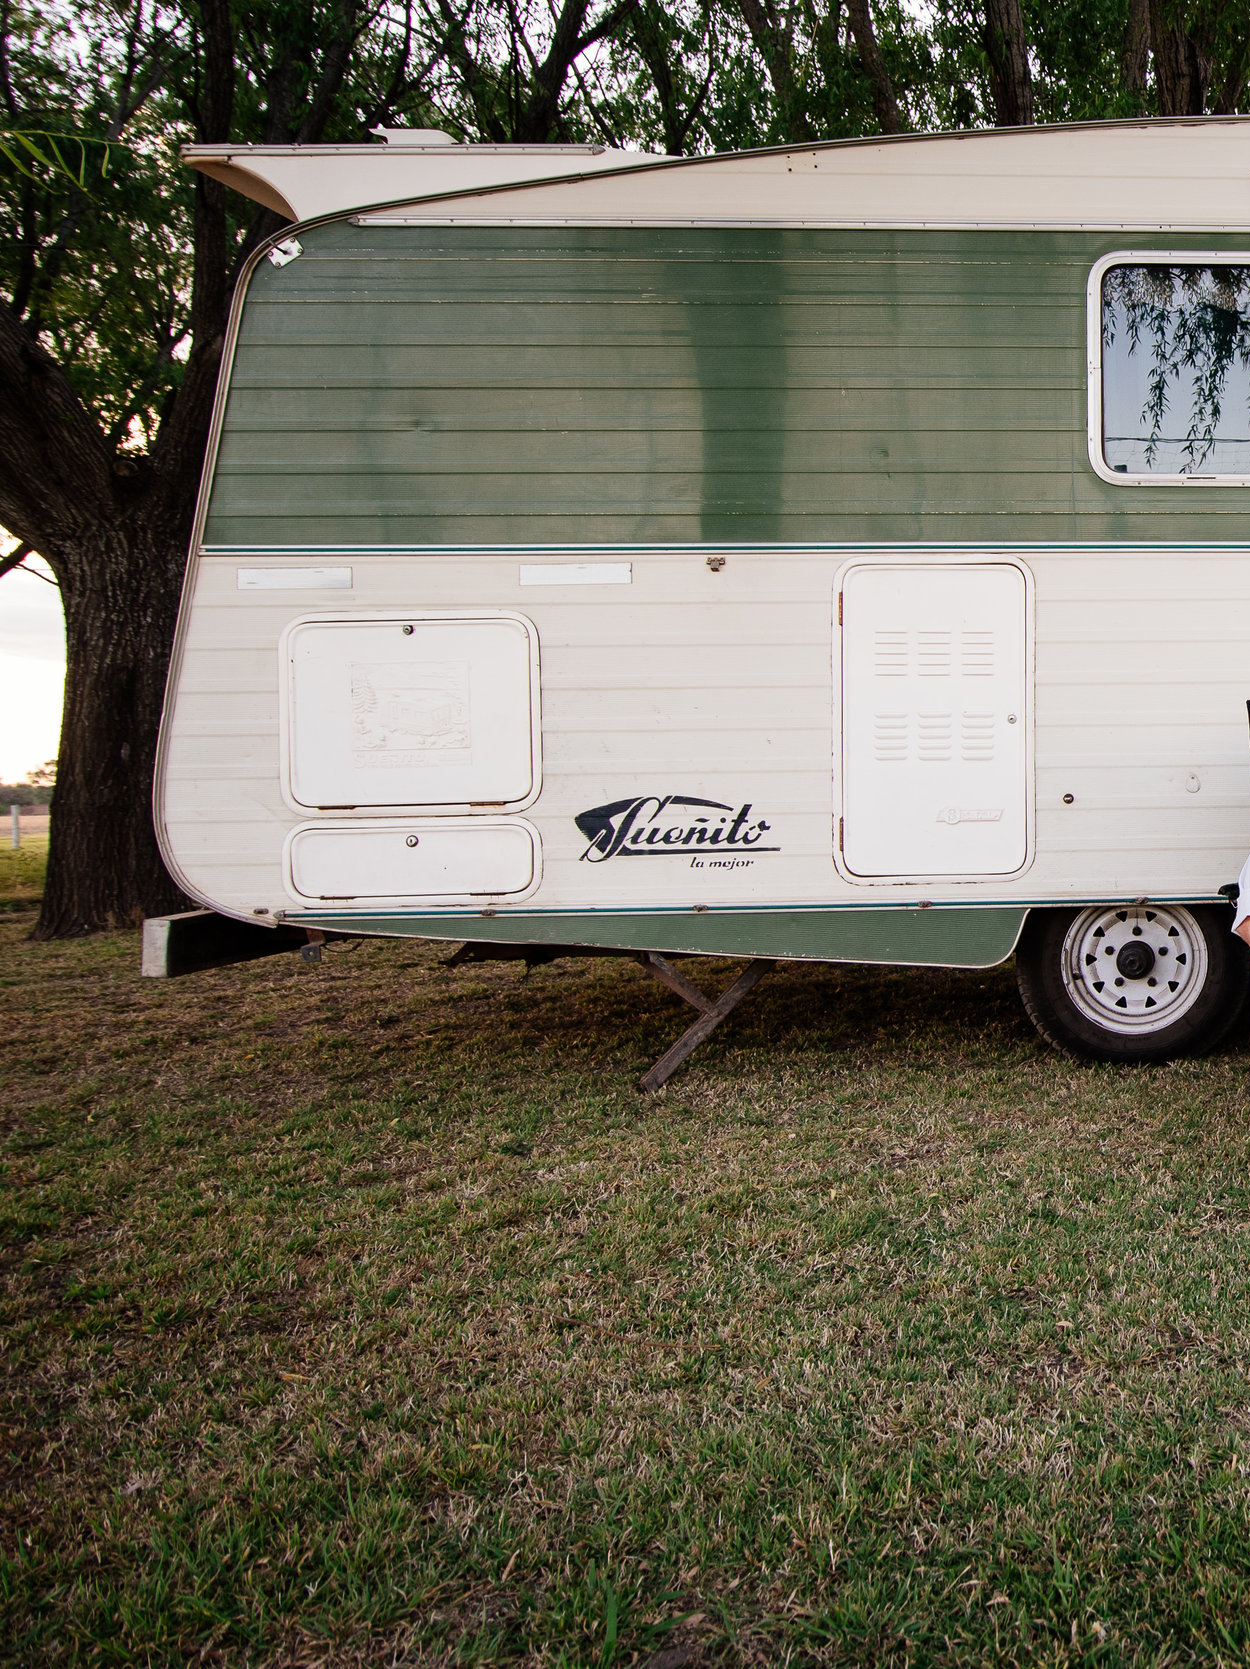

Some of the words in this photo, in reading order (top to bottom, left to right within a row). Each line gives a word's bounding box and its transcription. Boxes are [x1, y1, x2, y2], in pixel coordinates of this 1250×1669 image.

[579, 795, 771, 862] Sueñito
[690, 856, 704, 868] la
[709, 858, 754, 871] mejor
